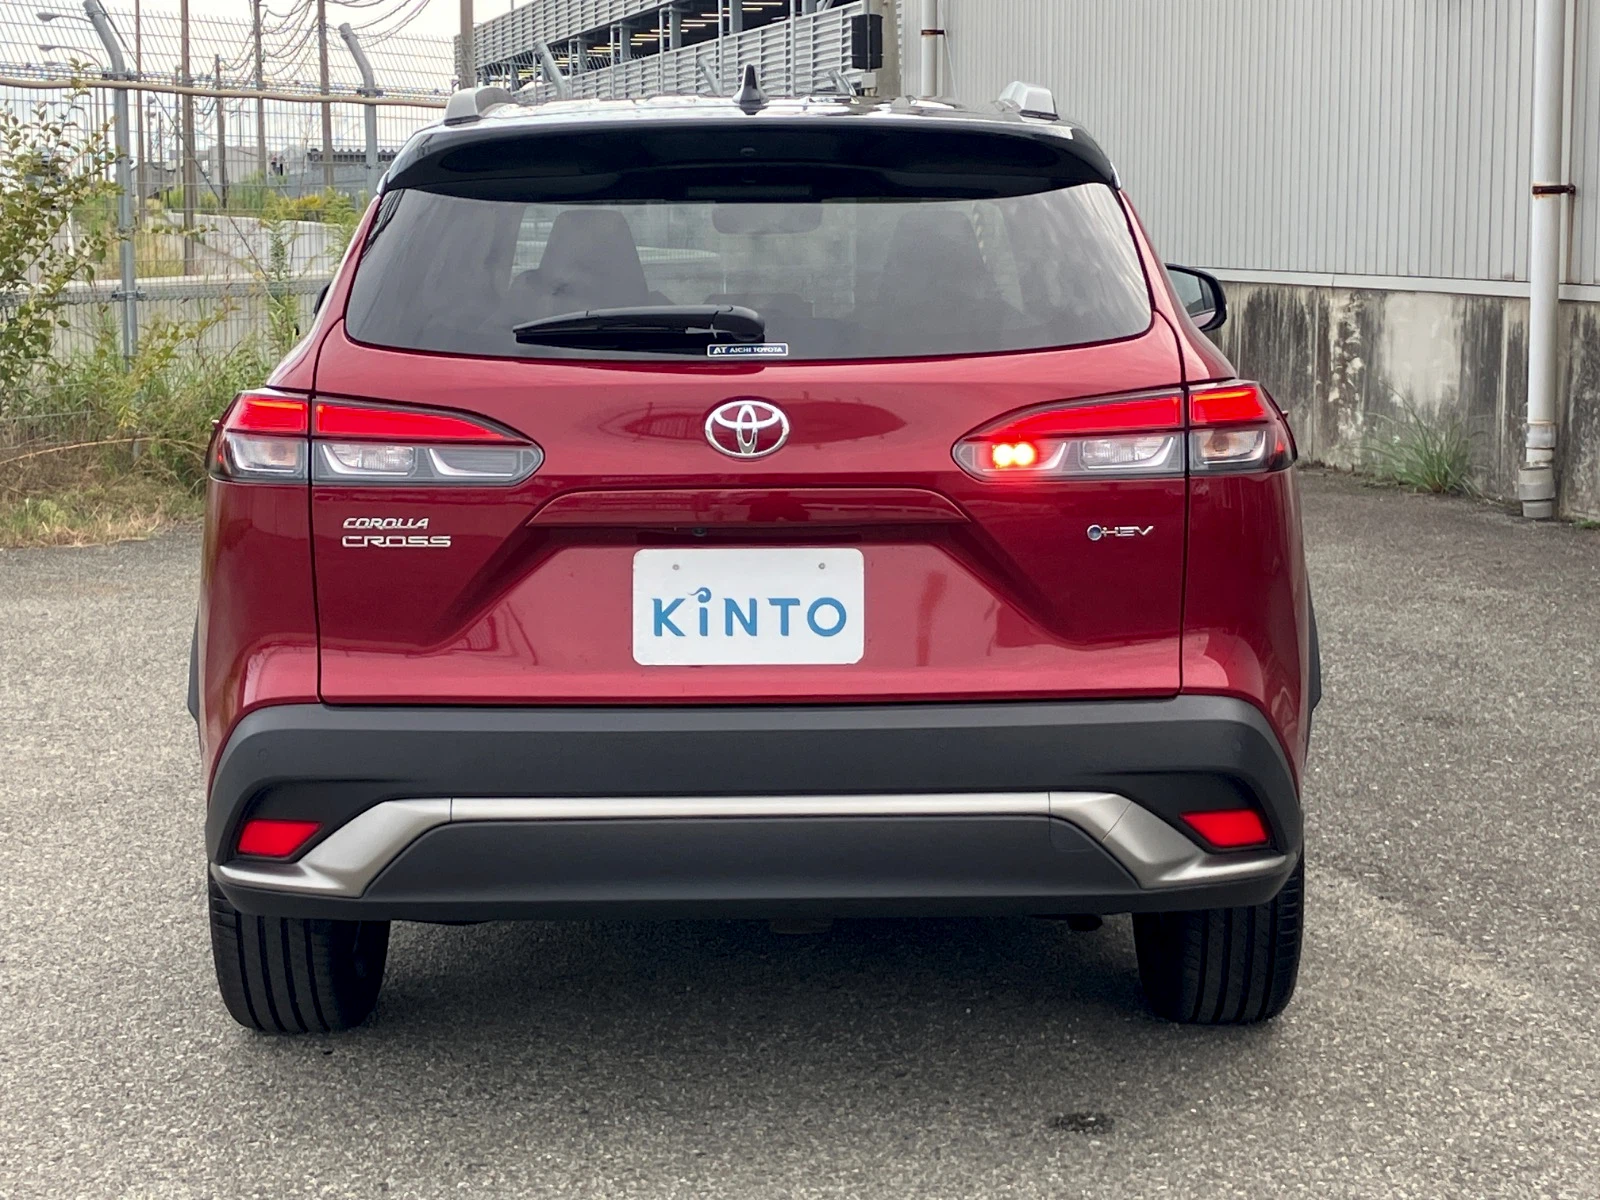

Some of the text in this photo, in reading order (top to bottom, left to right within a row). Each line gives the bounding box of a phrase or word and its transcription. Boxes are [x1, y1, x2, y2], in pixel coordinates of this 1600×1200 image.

[713, 346, 728, 354] AT
[343, 517, 429, 530] COROLLA
[342, 535, 451, 548] CROSS
